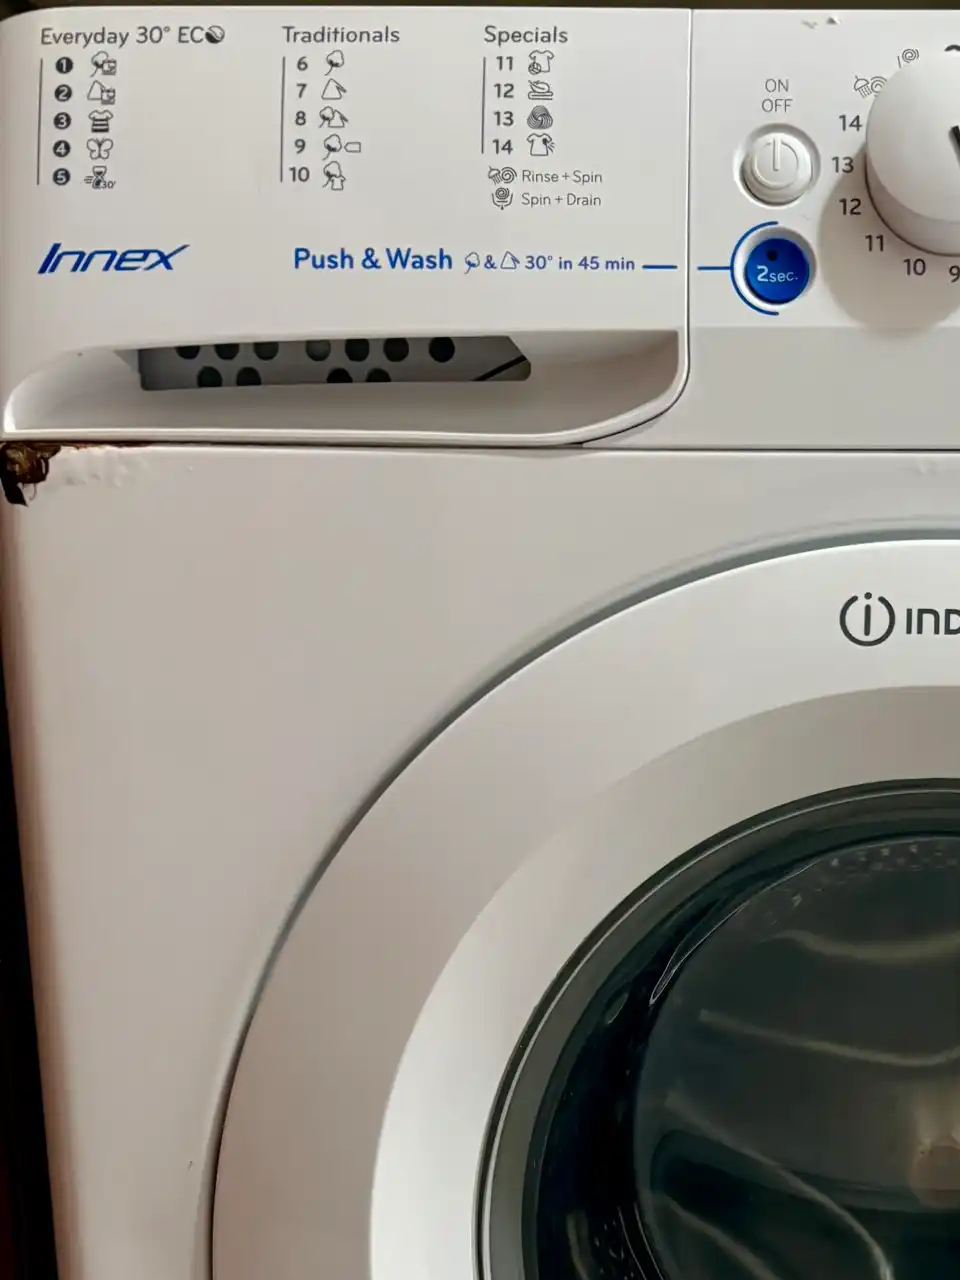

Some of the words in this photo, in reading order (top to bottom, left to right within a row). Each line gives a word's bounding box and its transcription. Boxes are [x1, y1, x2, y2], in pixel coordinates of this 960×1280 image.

[41, 26, 129, 49] Everyday
[136, 26, 170, 44] 30°
[282, 25, 400, 43] Traditionals
[484, 25, 568, 47] Specials
[297, 56, 308, 71] 6
[496, 56, 513, 71] 11
[296, 83, 307, 99] 7
[494, 83, 514, 98] 12
[765, 78, 789, 93] ON
[761, 98, 793, 113] OFF
[295, 110, 306, 126] 8
[494, 111, 514, 126] 13
[839, 115, 862, 132] 14
[294, 138, 306, 154] 9
[492, 139, 513, 155] 14
[831, 156, 855, 174] 13
[289, 166, 310, 182] 10
[522, 169, 559, 183] Rinse
[562, 172, 571, 181] +
[572, 169, 603, 186] Spin
[521, 192, 551, 208] Spin
[555, 195, 563, 204] +
[566, 192, 602, 206] Drain
[839, 198, 861, 215] 12
[865, 234, 884, 252] 11
[37, 243, 189, 275] Innex
[295, 248, 354, 269] Push
[361, 247, 382, 269] &
[386, 248, 452, 269] Wash
[484, 254, 497, 270] &
[525, 255, 553, 270] 30°
[559, 256, 572, 270] in
[578, 256, 600, 270] 45
[605, 257, 635, 270] min
[757, 265, 798, 283] 2sec.
[903, 258, 926, 276] 10
[949, 265, 960, 283] 9
